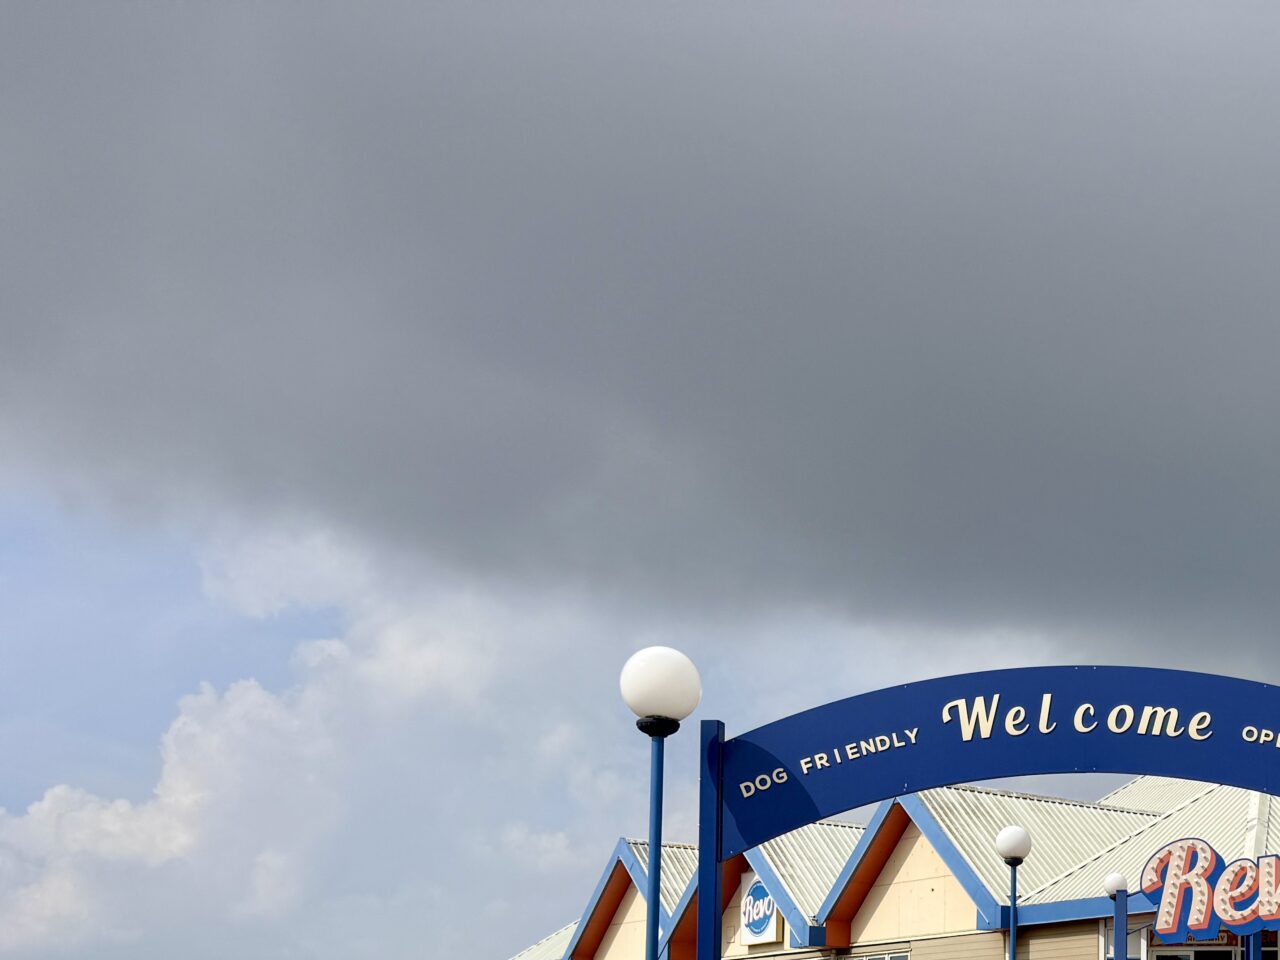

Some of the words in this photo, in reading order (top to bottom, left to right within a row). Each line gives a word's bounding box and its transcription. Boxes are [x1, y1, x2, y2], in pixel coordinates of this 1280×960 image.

[942, 693, 1213, 741] Welcome
[739, 767, 788, 798] DOG
[800, 727, 919, 774] FRIENDLY
[743, 895, 775, 925] Revo
